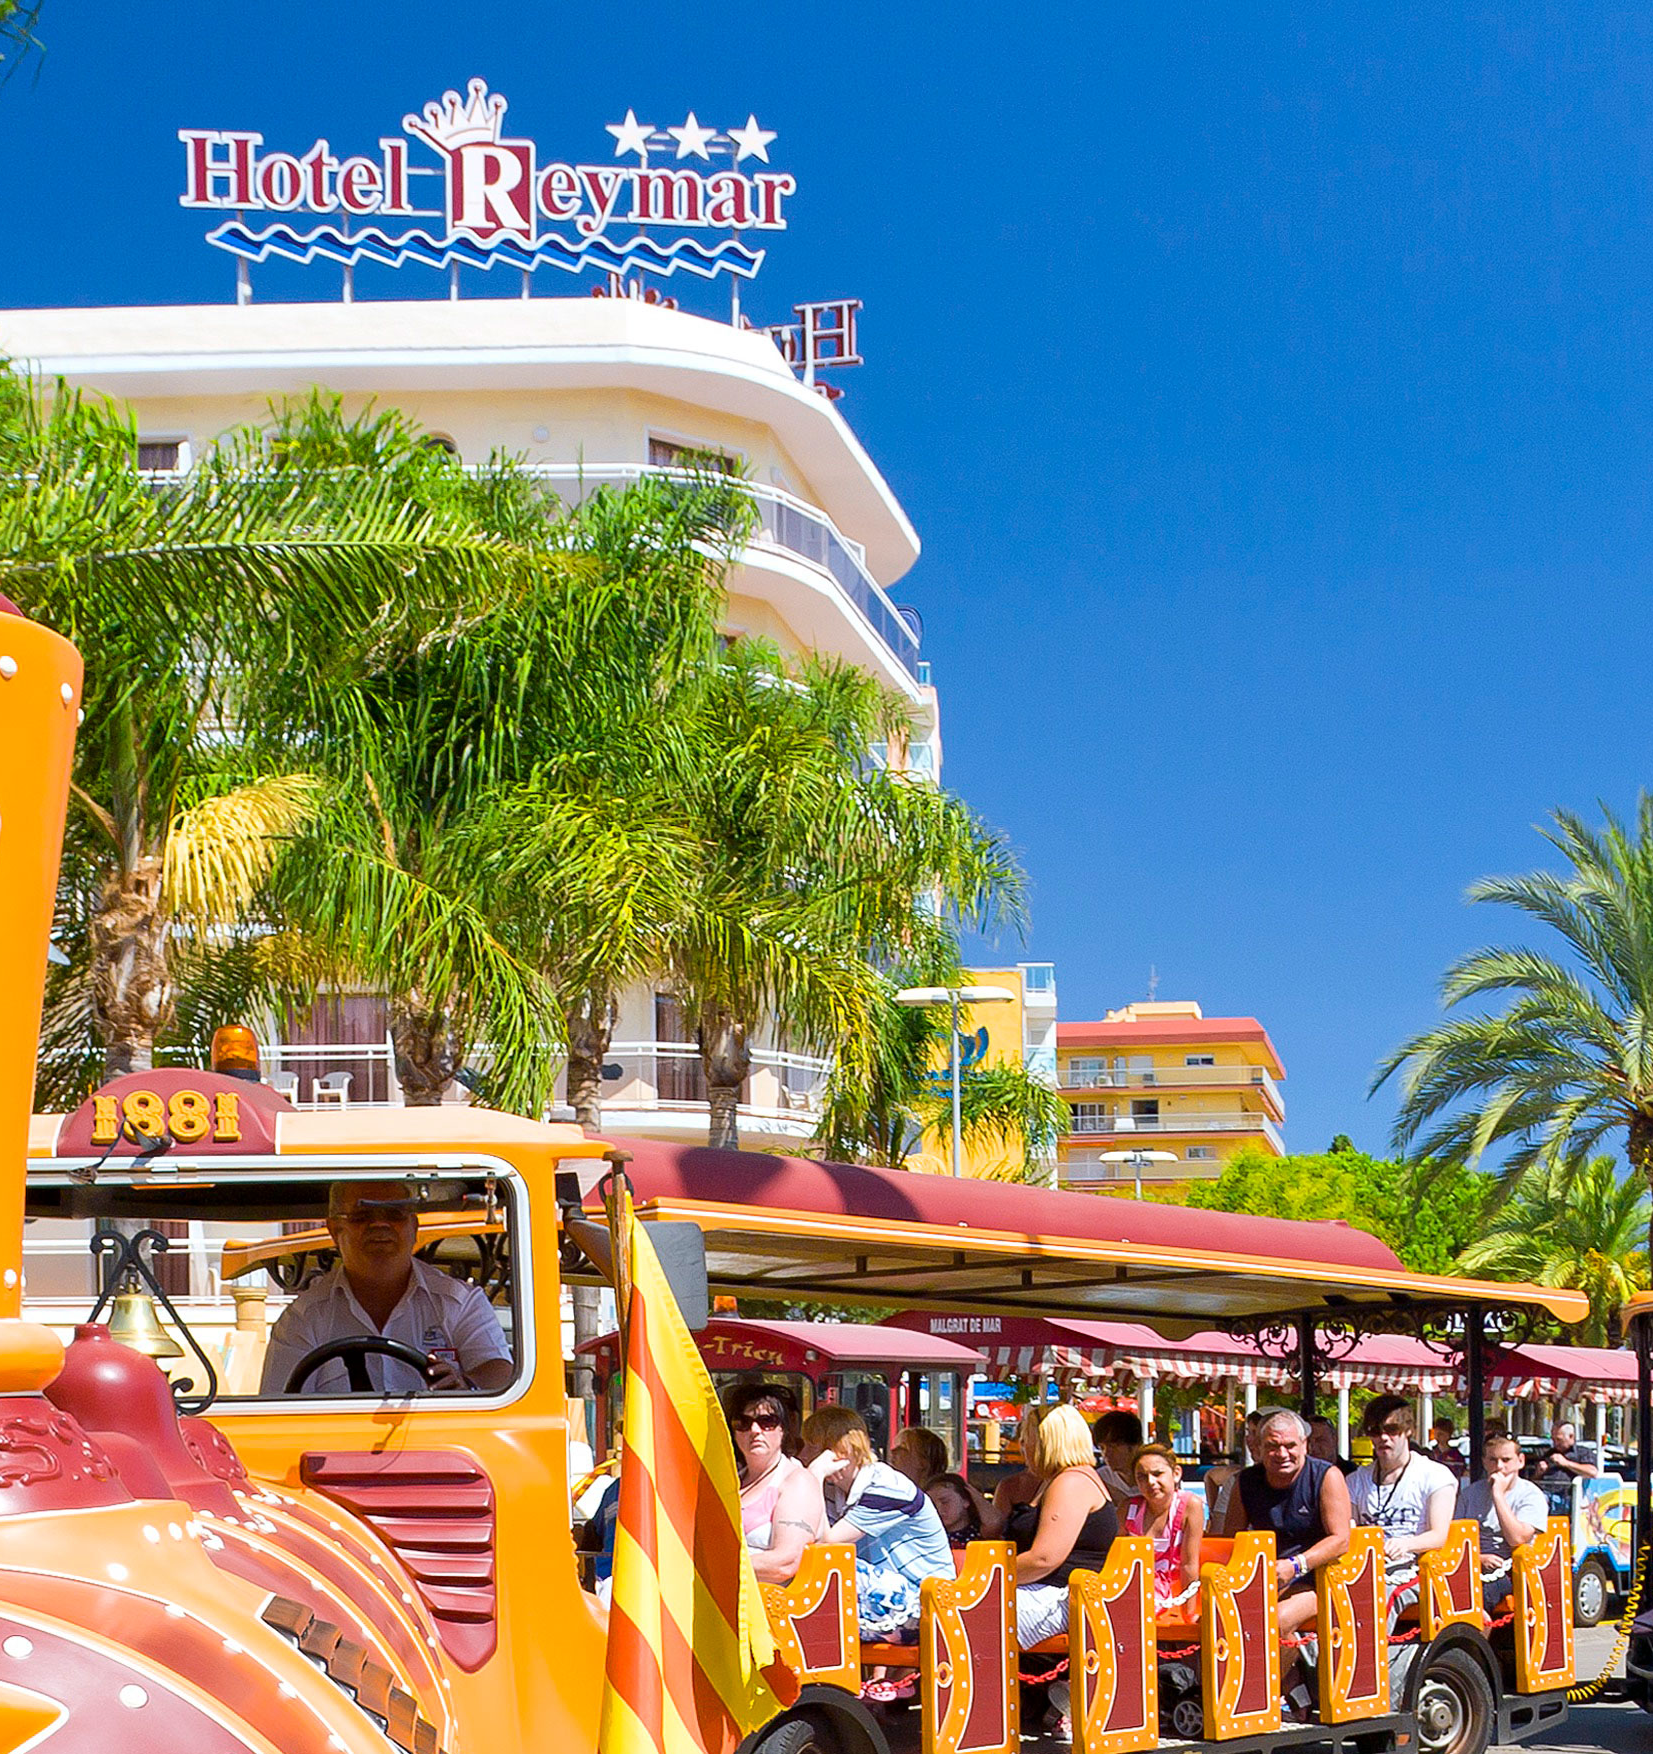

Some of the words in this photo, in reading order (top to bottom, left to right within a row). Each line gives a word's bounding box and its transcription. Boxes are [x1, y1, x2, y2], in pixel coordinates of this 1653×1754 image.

[179, 129, 410, 215] Hotel
[450, 140, 796, 236] Reymar
[91, 1089, 242, 1145] 1881
[930, 1318, 967, 1333] MALGRAT
[969, 1318, 981, 1333] DE
[982, 1318, 1002, 1333] MAR
